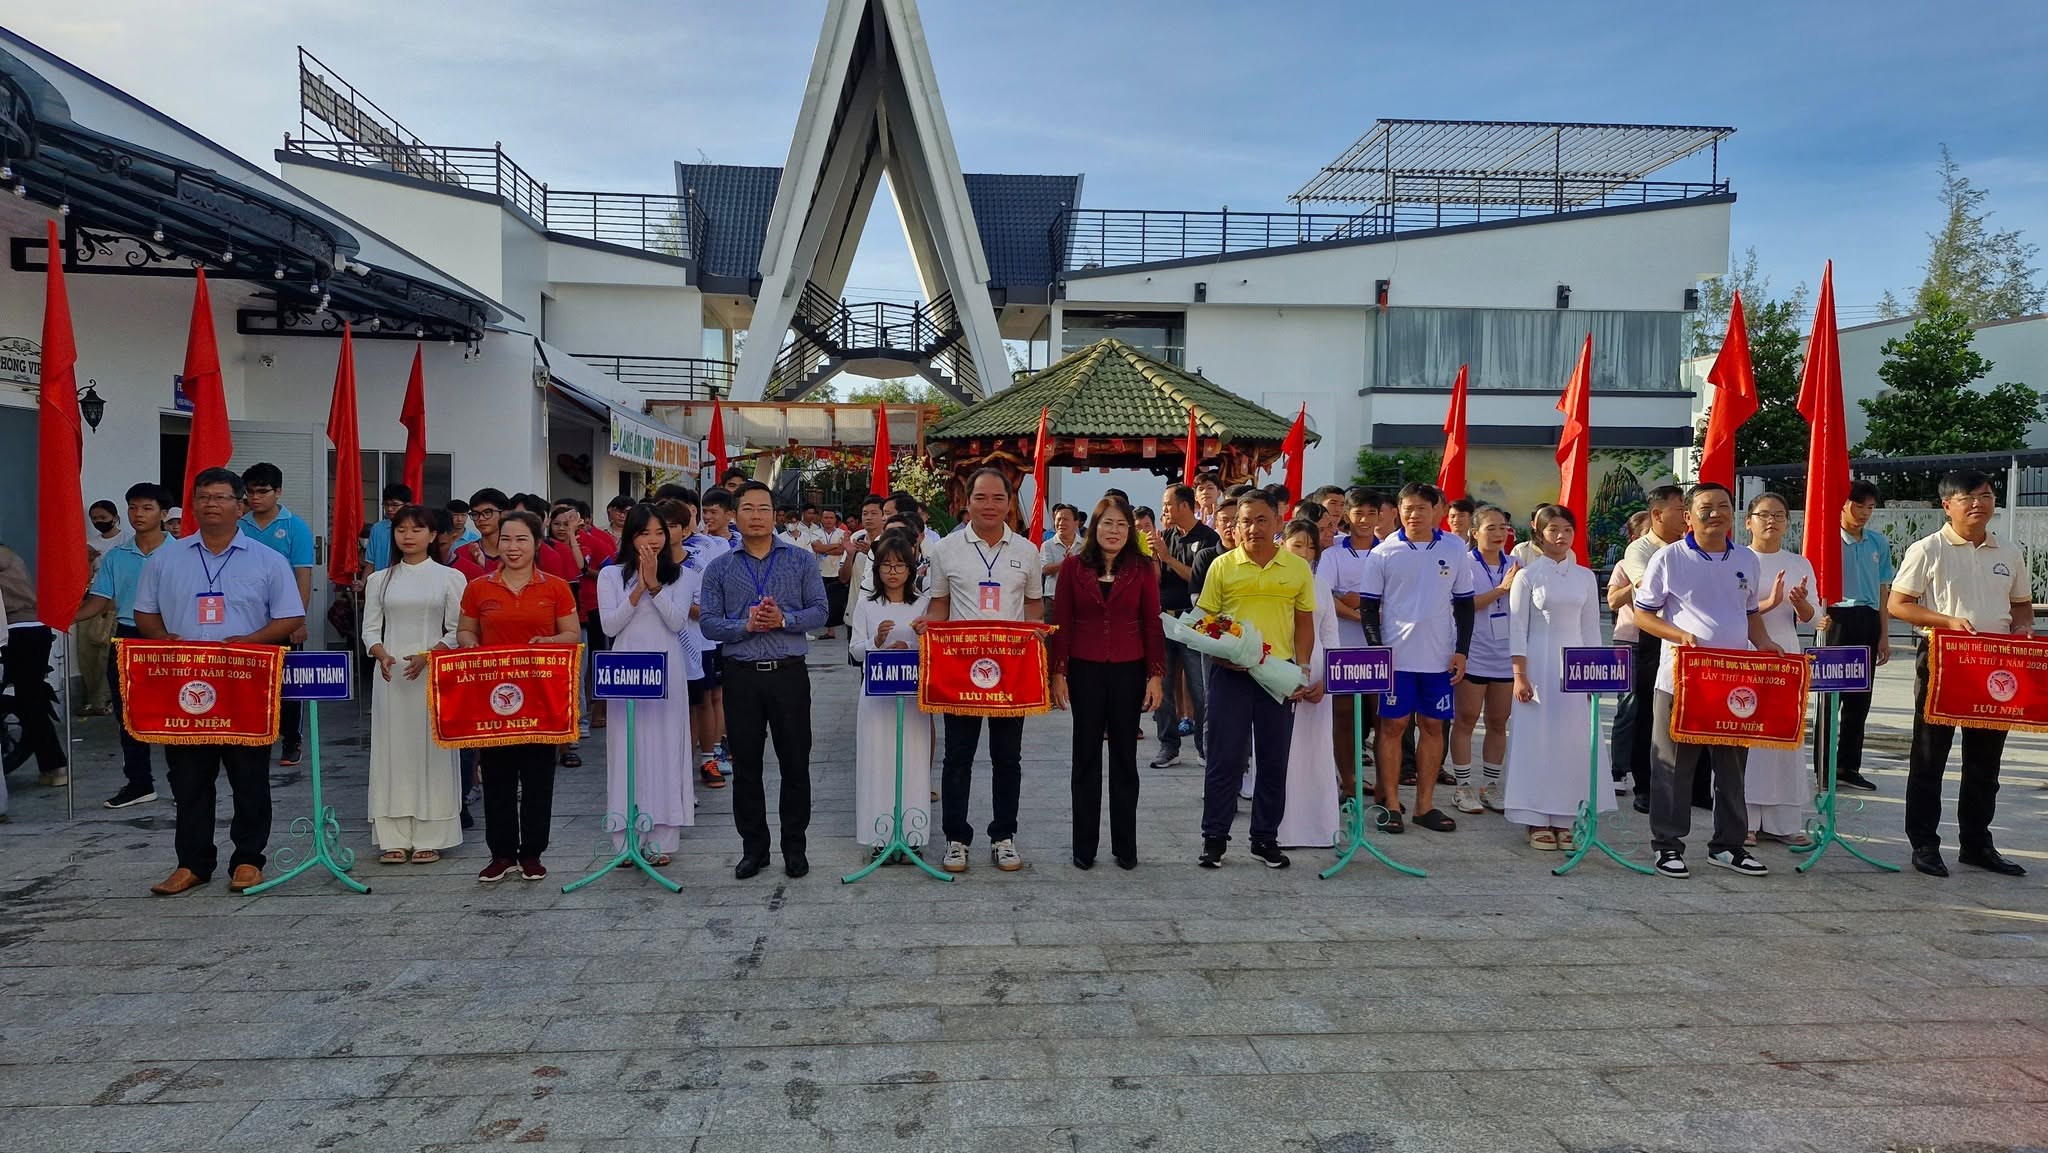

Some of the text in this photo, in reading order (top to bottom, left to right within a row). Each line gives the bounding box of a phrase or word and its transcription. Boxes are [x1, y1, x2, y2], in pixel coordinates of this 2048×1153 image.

[0, 353, 27, 373] HÒNG
[258, 659, 267, 668] 12
[558, 656, 567, 666] 12
[293, 667, 315, 688] ĐỊNH
[315, 664, 345, 684] THÀNH
[597, 665, 662, 686] XÃ GÀNH HÀO
[870, 662, 919, 685] XÃ AN TRẠ
[1569, 661, 1582, 681] XÃ
[1791, 666, 1800, 675] 12
[1822, 663, 1844, 680] LONG
[164, 716, 232, 730] LƯU NIỆM
[476, 716, 538, 731] LƯU NIỆM
